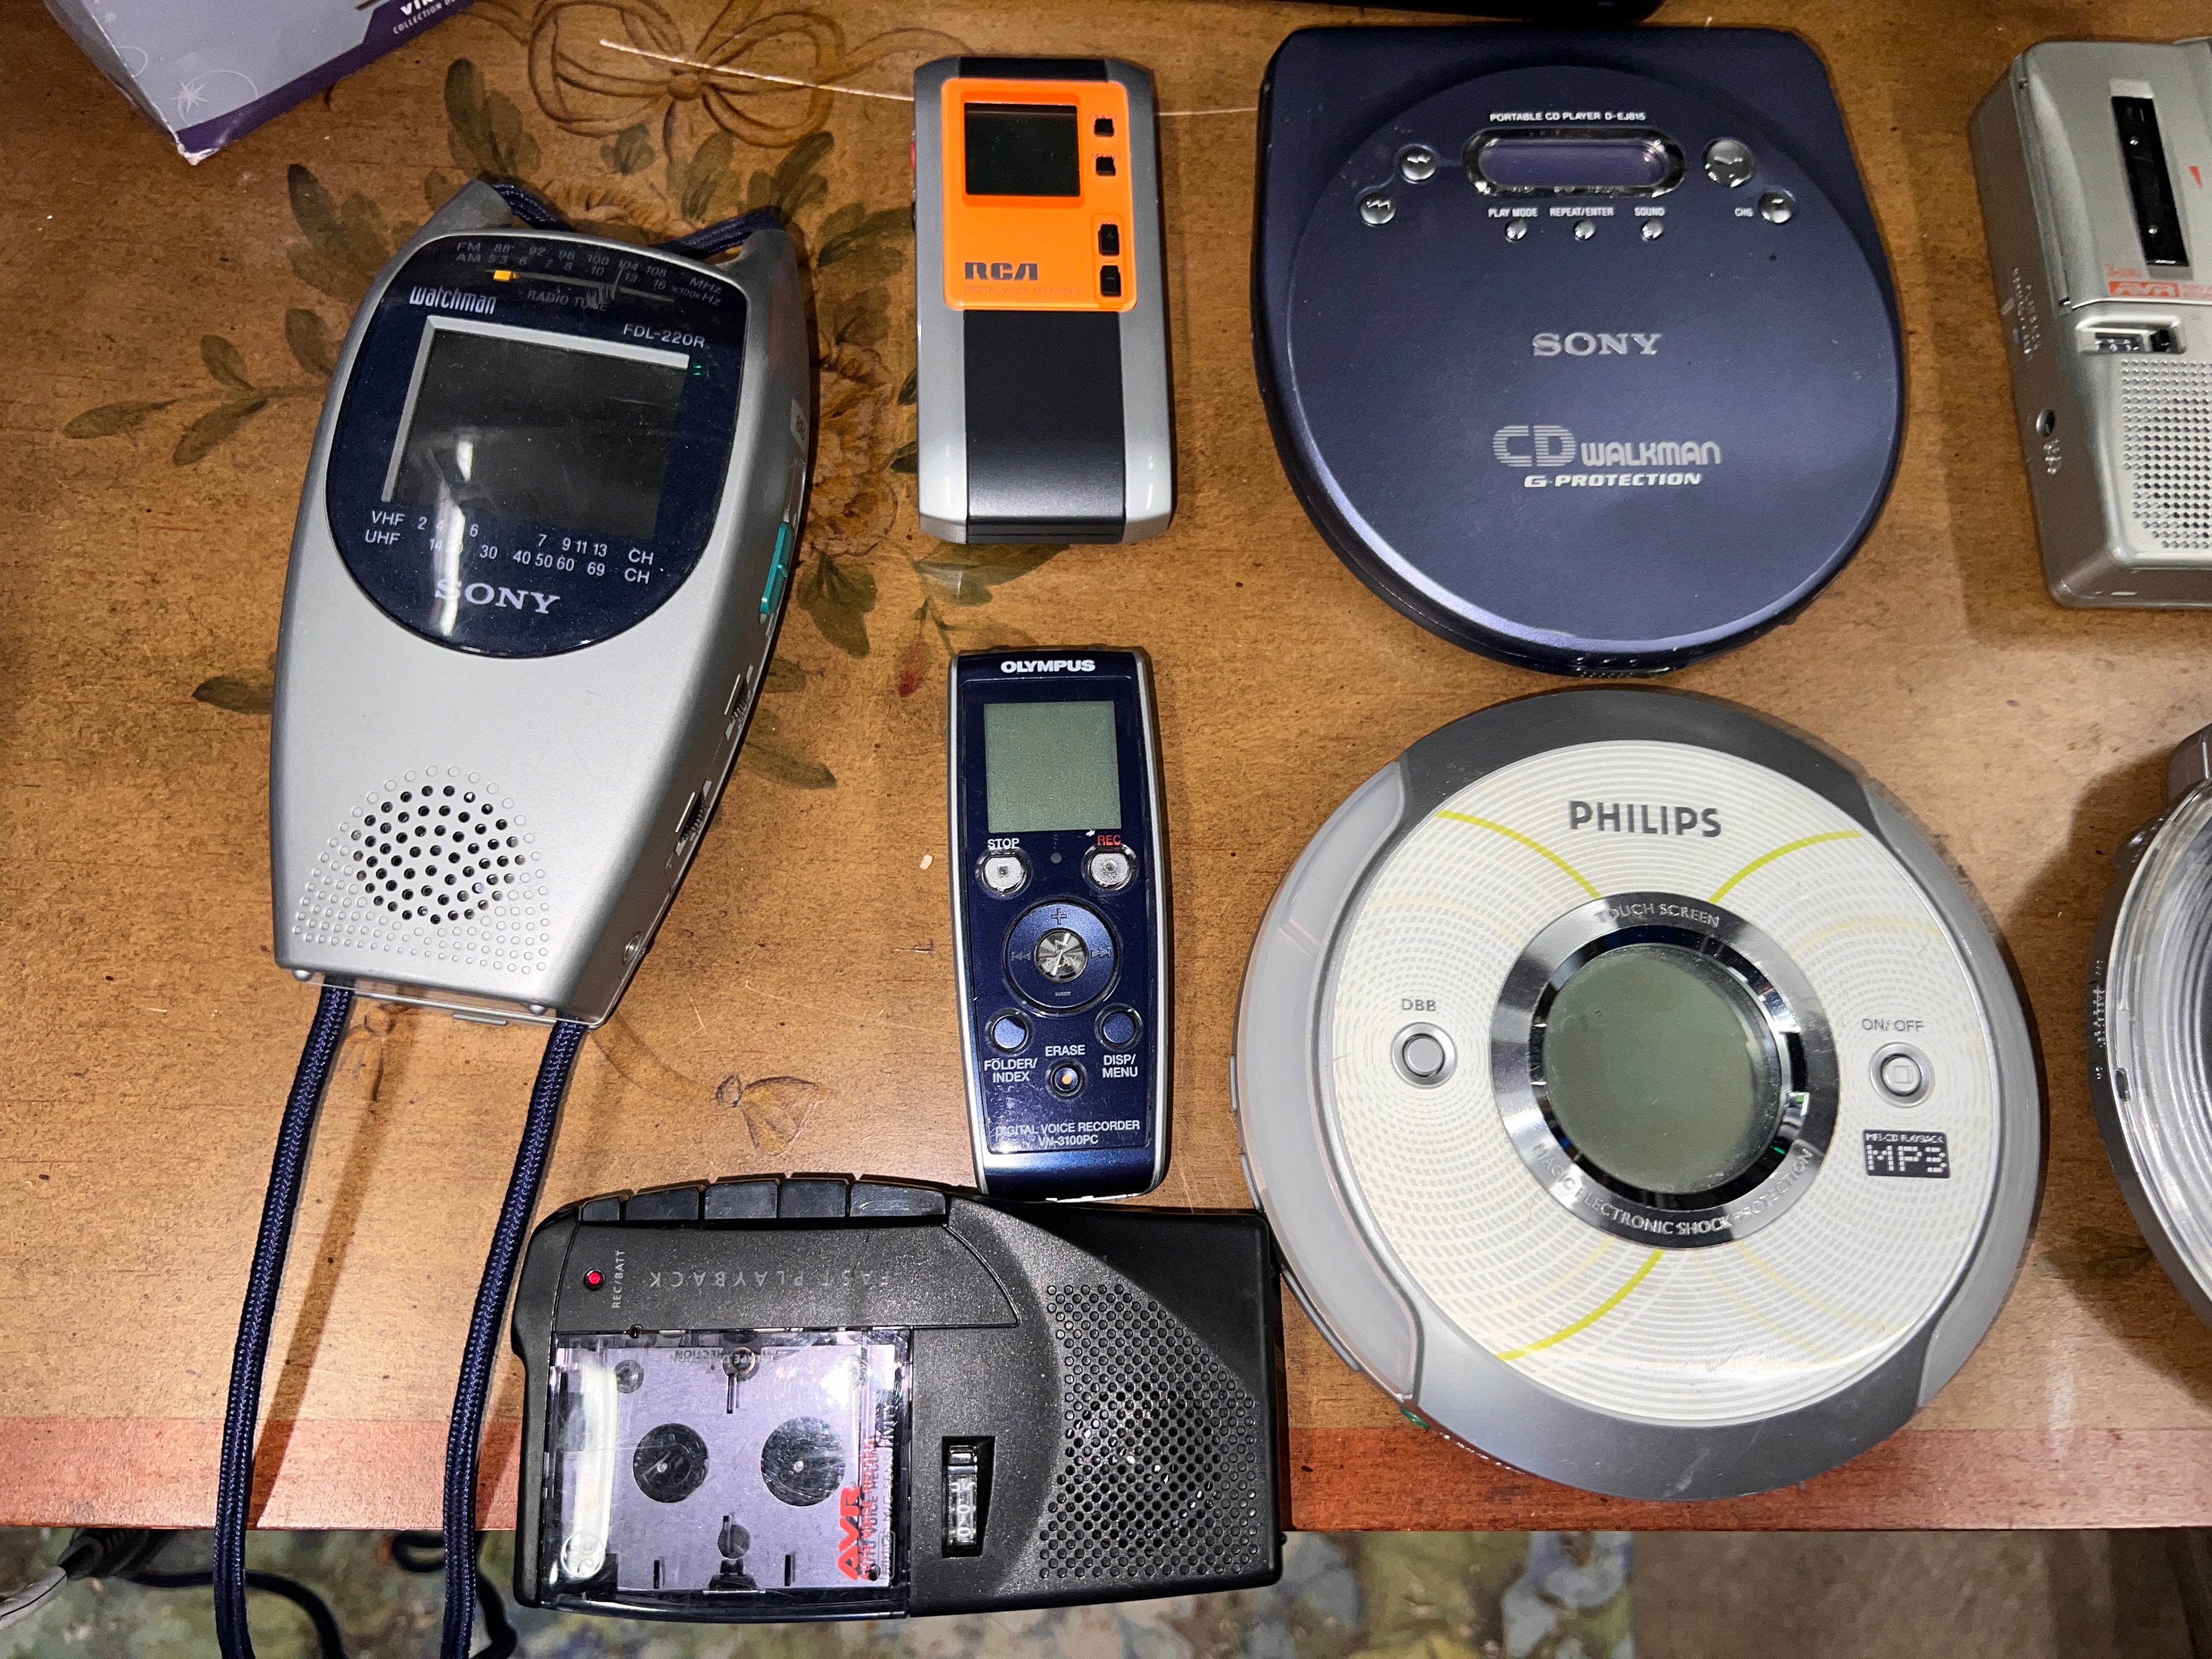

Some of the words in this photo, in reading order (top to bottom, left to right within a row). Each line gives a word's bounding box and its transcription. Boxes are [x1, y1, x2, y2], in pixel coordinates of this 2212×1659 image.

[393, 2, 442, 35] COLLECTION
[1489, 112, 1543, 122] PORTABLE
[1544, 112, 1561, 121] CD
[1562, 111, 1601, 121] PLAYER
[1487, 207, 1511, 218] PLAY
[1512, 207, 1539, 218] MODE
[1549, 207, 1614, 217] REPEAT/ENTER
[1634, 207, 1666, 217] SOUND
[1734, 207, 1755, 218] CHG
[455, 253, 482, 263] AM
[590, 265, 605, 276] 10
[457, 242, 482, 253] FM
[689, 276, 723, 295] MHz
[964, 262, 1039, 282] RCA
[526, 289, 570, 306] RADIO
[963, 286, 999, 294] DIGITAL
[1003, 286, 1028, 295] VOICE
[1032, 286, 1082, 296] RECORDER
[623, 323, 706, 349] FDL-220R
[1532, 331, 1662, 357] SONY
[1492, 424, 1577, 468] CD
[1580, 441, 1722, 467] WALKMAN
[1524, 472, 1702, 488] G-PROTECTION
[371, 510, 406, 526] VHF
[417, 516, 427, 531] 2
[435, 520, 445, 532] 4
[469, 524, 479, 537] 6
[539, 533, 548, 547] 7
[562, 537, 571, 551] 9
[575, 540, 588, 554] 11
[593, 543, 608, 558] 13
[628, 548, 654, 566] CH
[364, 529, 401, 546] UHF
[429, 538, 444, 552] 14
[479, 544, 499, 560] 30
[513, 548, 532, 565] 40
[535, 553, 554, 569] 50
[556, 555, 575, 573] 60
[586, 560, 606, 577] 69
[624, 567, 650, 585] CH
[435, 578, 560, 615] SONY
[1000, 659, 1096, 673] OLYMPUS
[1567, 800, 1722, 838] PHILIPS
[987, 837, 1021, 850] STOP
[1096, 834, 1122, 846] REC
[1593, 903, 1656, 923] TOUCH
[1658, 903, 1720, 929] SCREEN
[1402, 998, 1437, 1012] DBB
[1044, 1044, 1086, 1057] ERASE
[1103, 1053, 1137, 1066] DISP/
[983, 1057, 1038, 1071] FOLDER/
[1102, 1065, 1139, 1079] MENU
[992, 1070, 1031, 1083] INDEX
[995, 1123, 1039, 1137] DIGITAL
[1040, 1122, 1076, 1134] VOICE
[1077, 1119, 1141, 1133] RECORDER
[1038, 1134, 1099, 1147] VN-3100PC
[1866, 1144, 1948, 1173] MP3
[1531, 1141, 1577, 1191] MAGIC
[1574, 1187, 1675, 1235] ELECTRONIC
[1675, 1213, 1733, 1236] SHOCK
[1733, 1147, 1814, 1222] PROTECTION
[611, 1249, 626, 1309] REC/BATT
[649, 1270, 804, 1288] PLAYBACK
[820, 1270, 889, 1287] FAST
[860, 1501, 873, 1539] VOICE
[838, 1486, 860, 1580] AVR
[859, 1544, 873, 1580] AUTO
